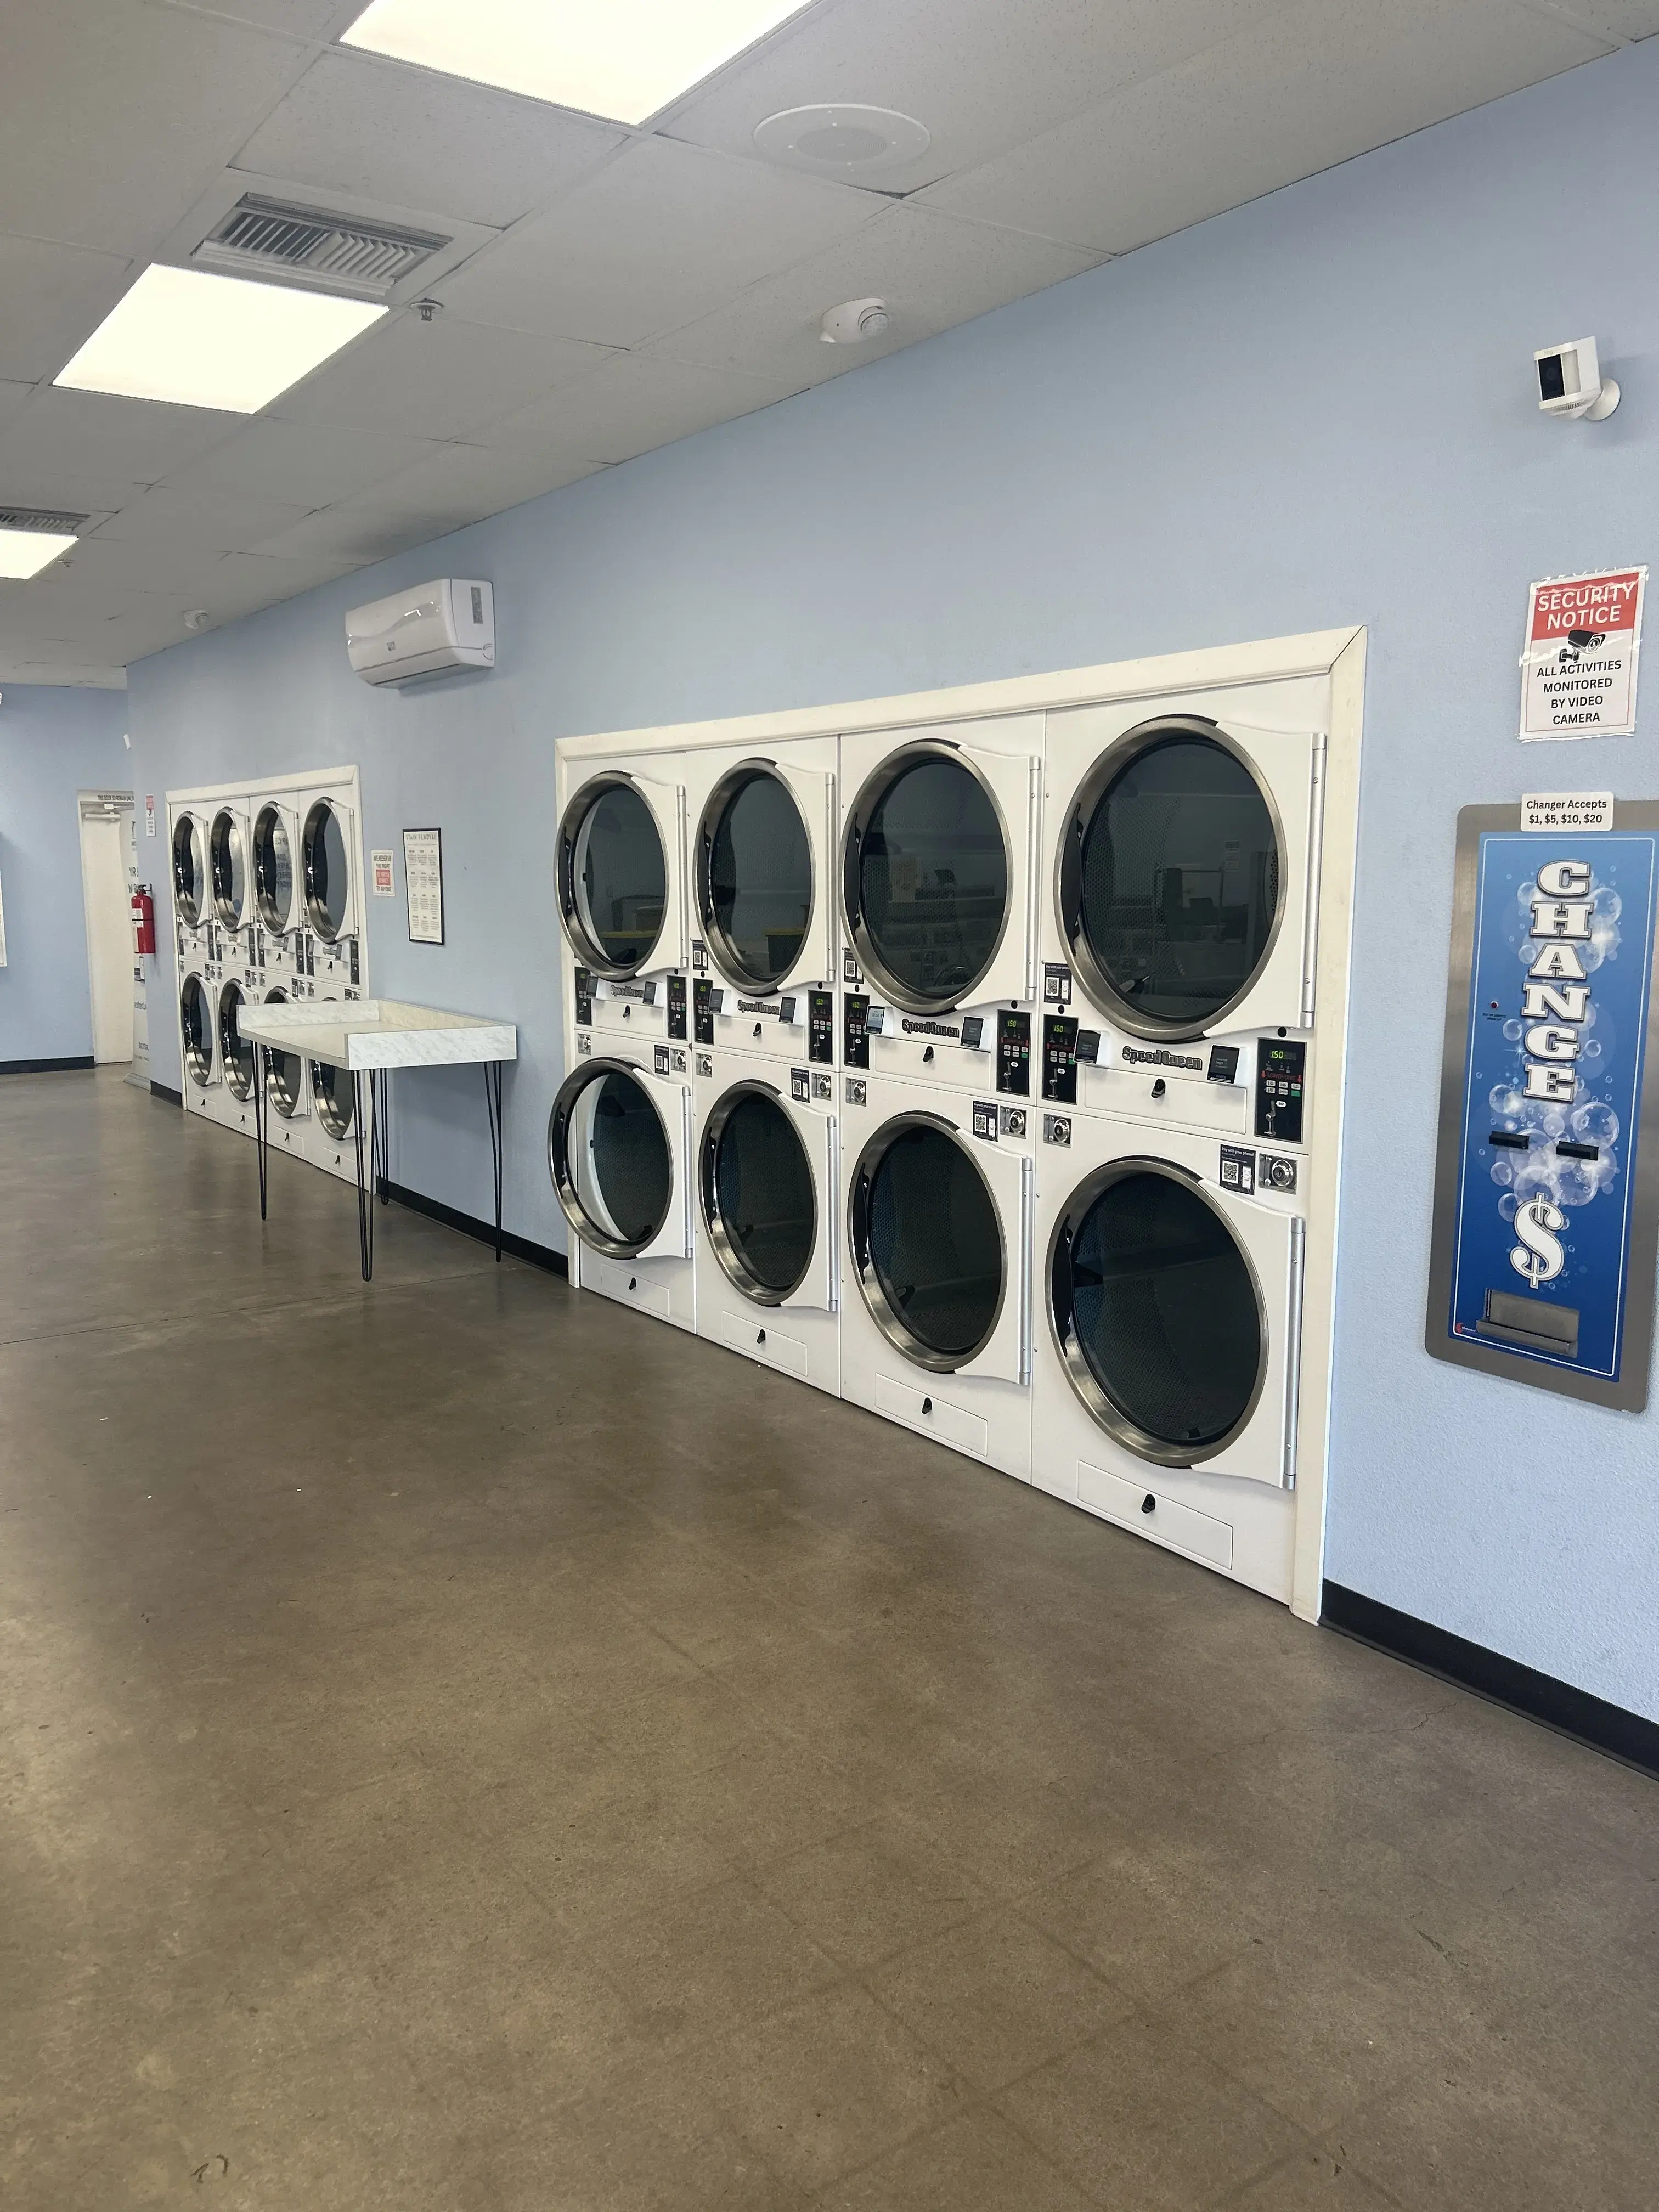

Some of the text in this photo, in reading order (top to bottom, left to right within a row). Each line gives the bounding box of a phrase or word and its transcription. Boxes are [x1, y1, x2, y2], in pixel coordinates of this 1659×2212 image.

[1538, 583, 1635, 612] SECURITY
[1547, 605, 1622, 630] NOTICE
[1537, 659, 1622, 678] ALL ACTIVITIES
[1543, 678, 1613, 693] MONITORED
[1551, 695, 1604, 709] BY VIDEO
[1553, 712, 1600, 725] CAMERA
[1526, 800, 1607, 811] Changer Accepts
[1528, 813, 1602, 825] $1, $5, $10, $20
[1520, 858, 1594, 1104] CHANGE
[902, 1019, 930, 1034] Speed
[930, 1022, 960, 1039] Queen
[1122, 1046, 1203, 1071] Speed Queen
